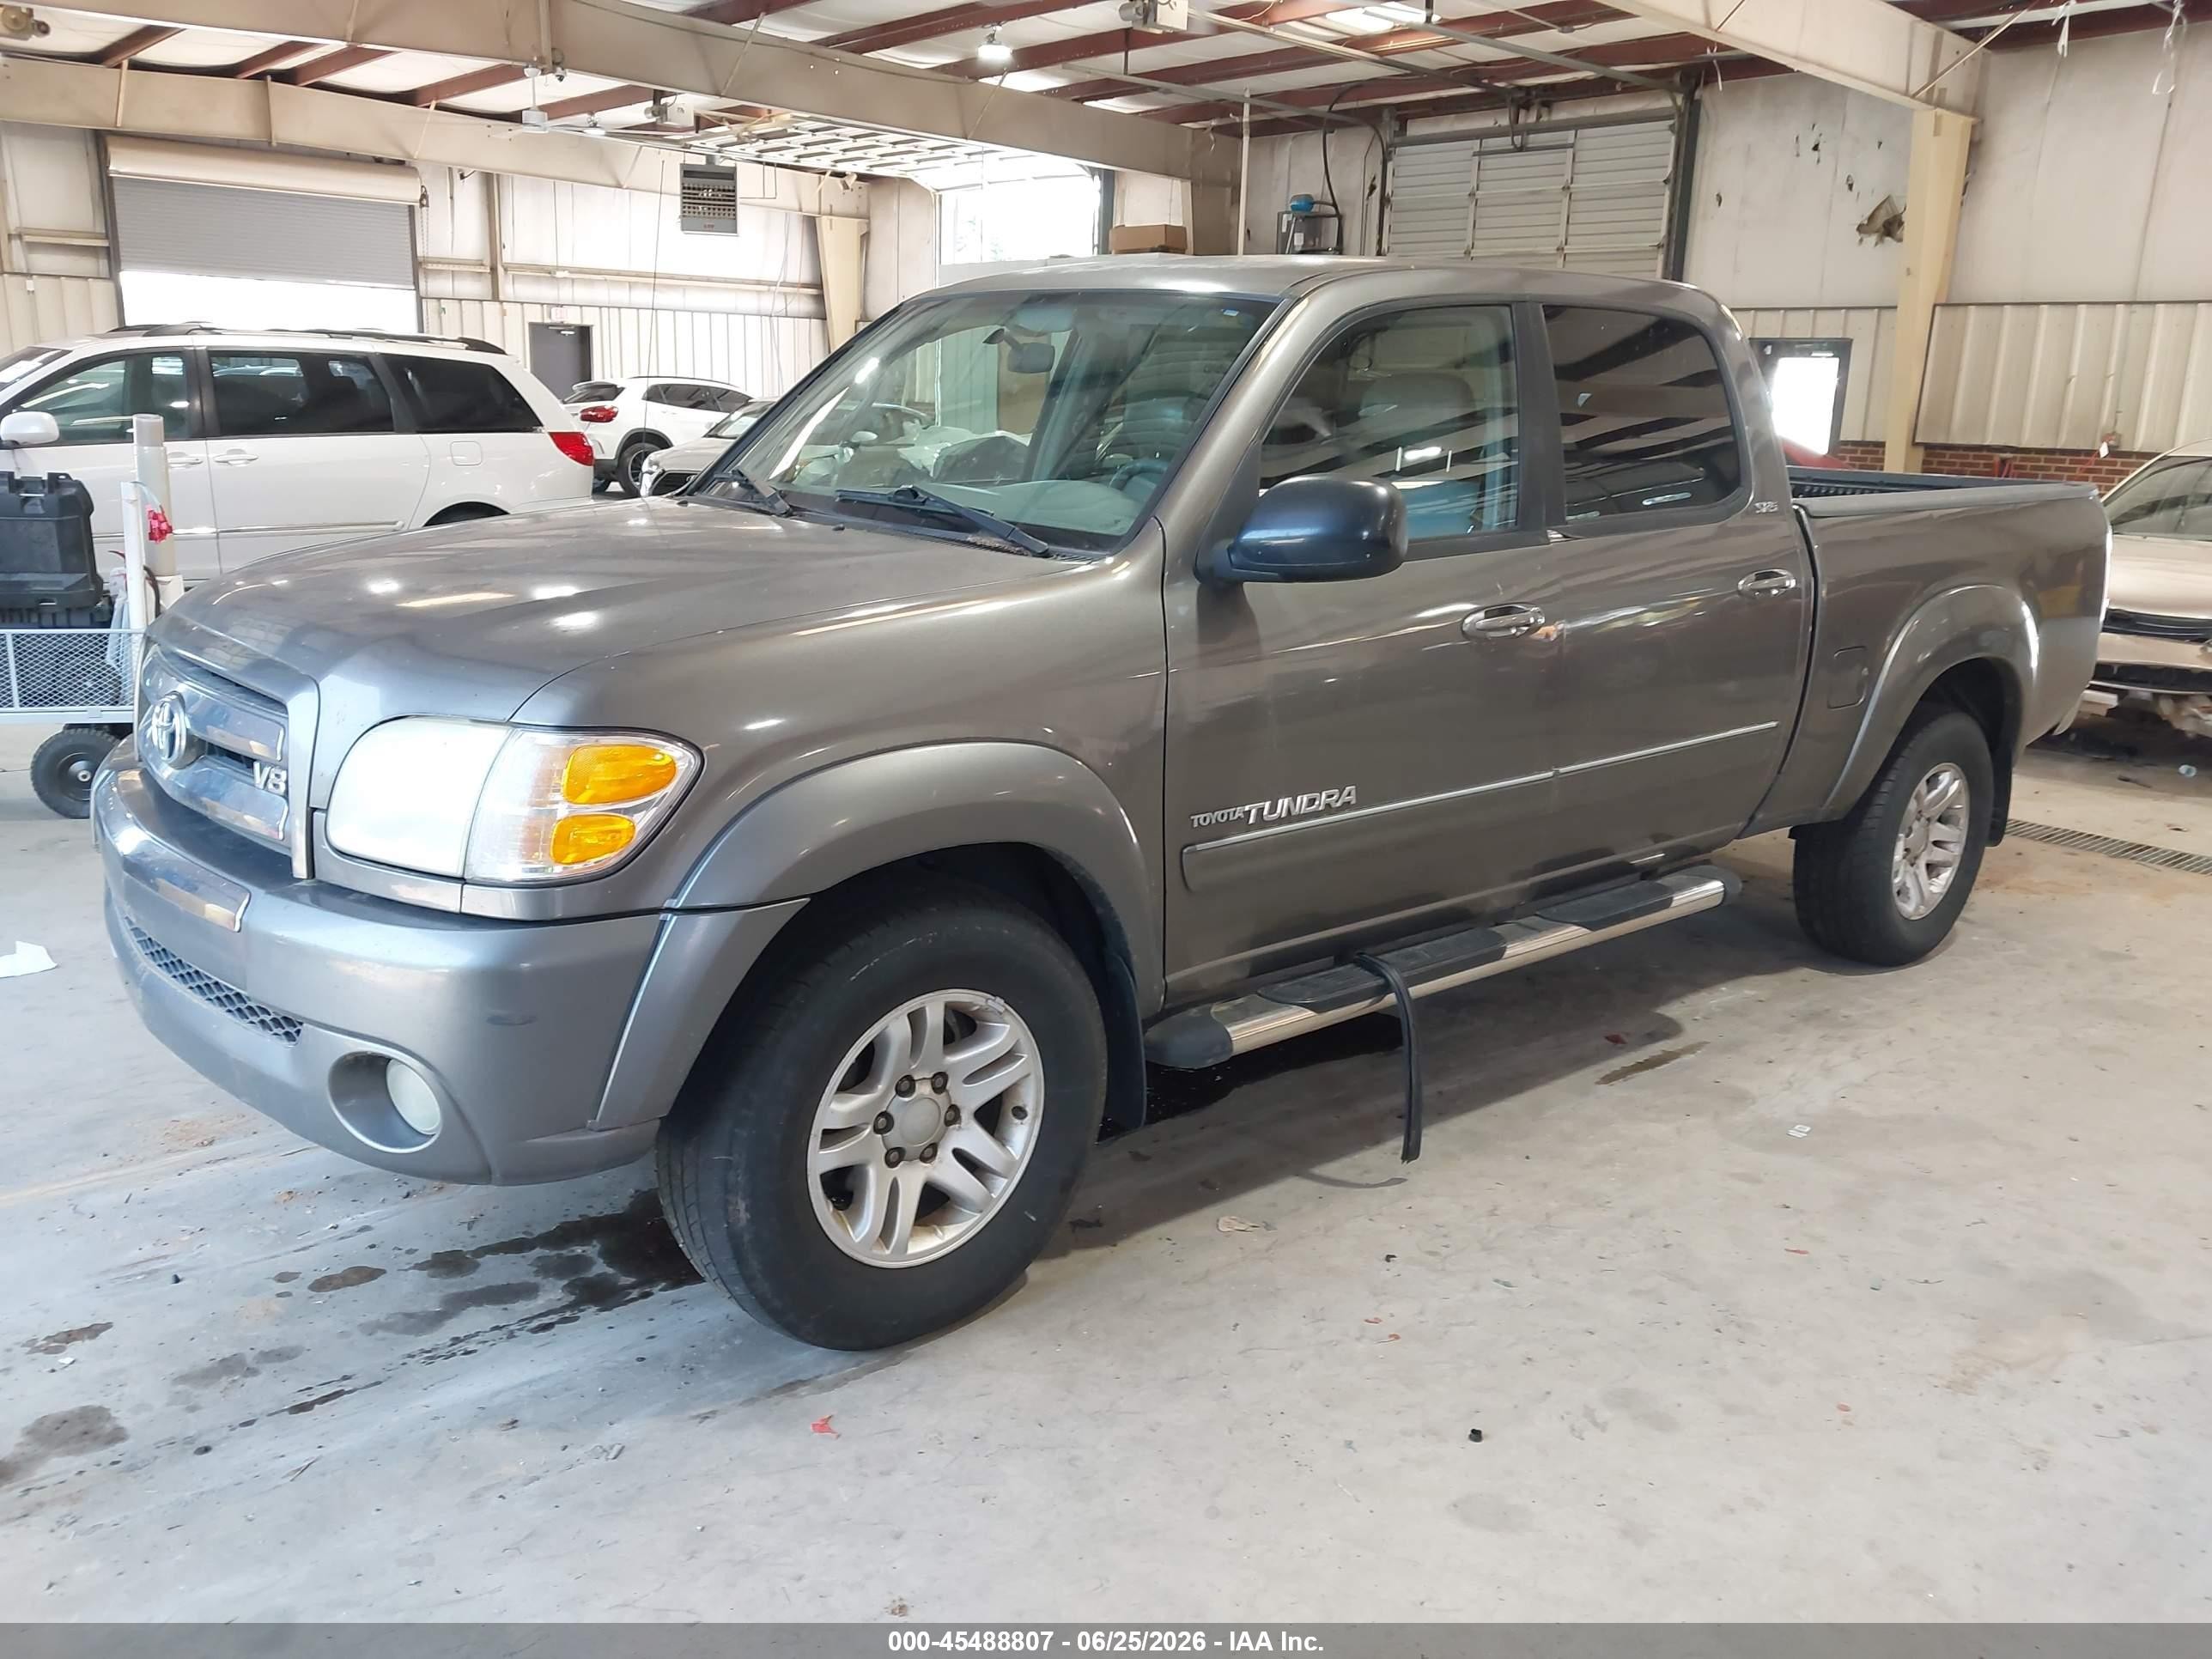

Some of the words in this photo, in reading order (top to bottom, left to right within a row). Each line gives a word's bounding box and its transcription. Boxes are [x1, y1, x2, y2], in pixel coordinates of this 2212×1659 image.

[253, 761, 287, 796] V8
[1190, 806, 1245, 828] TOYOTA
[1245, 785, 1357, 824] TUNDRA
